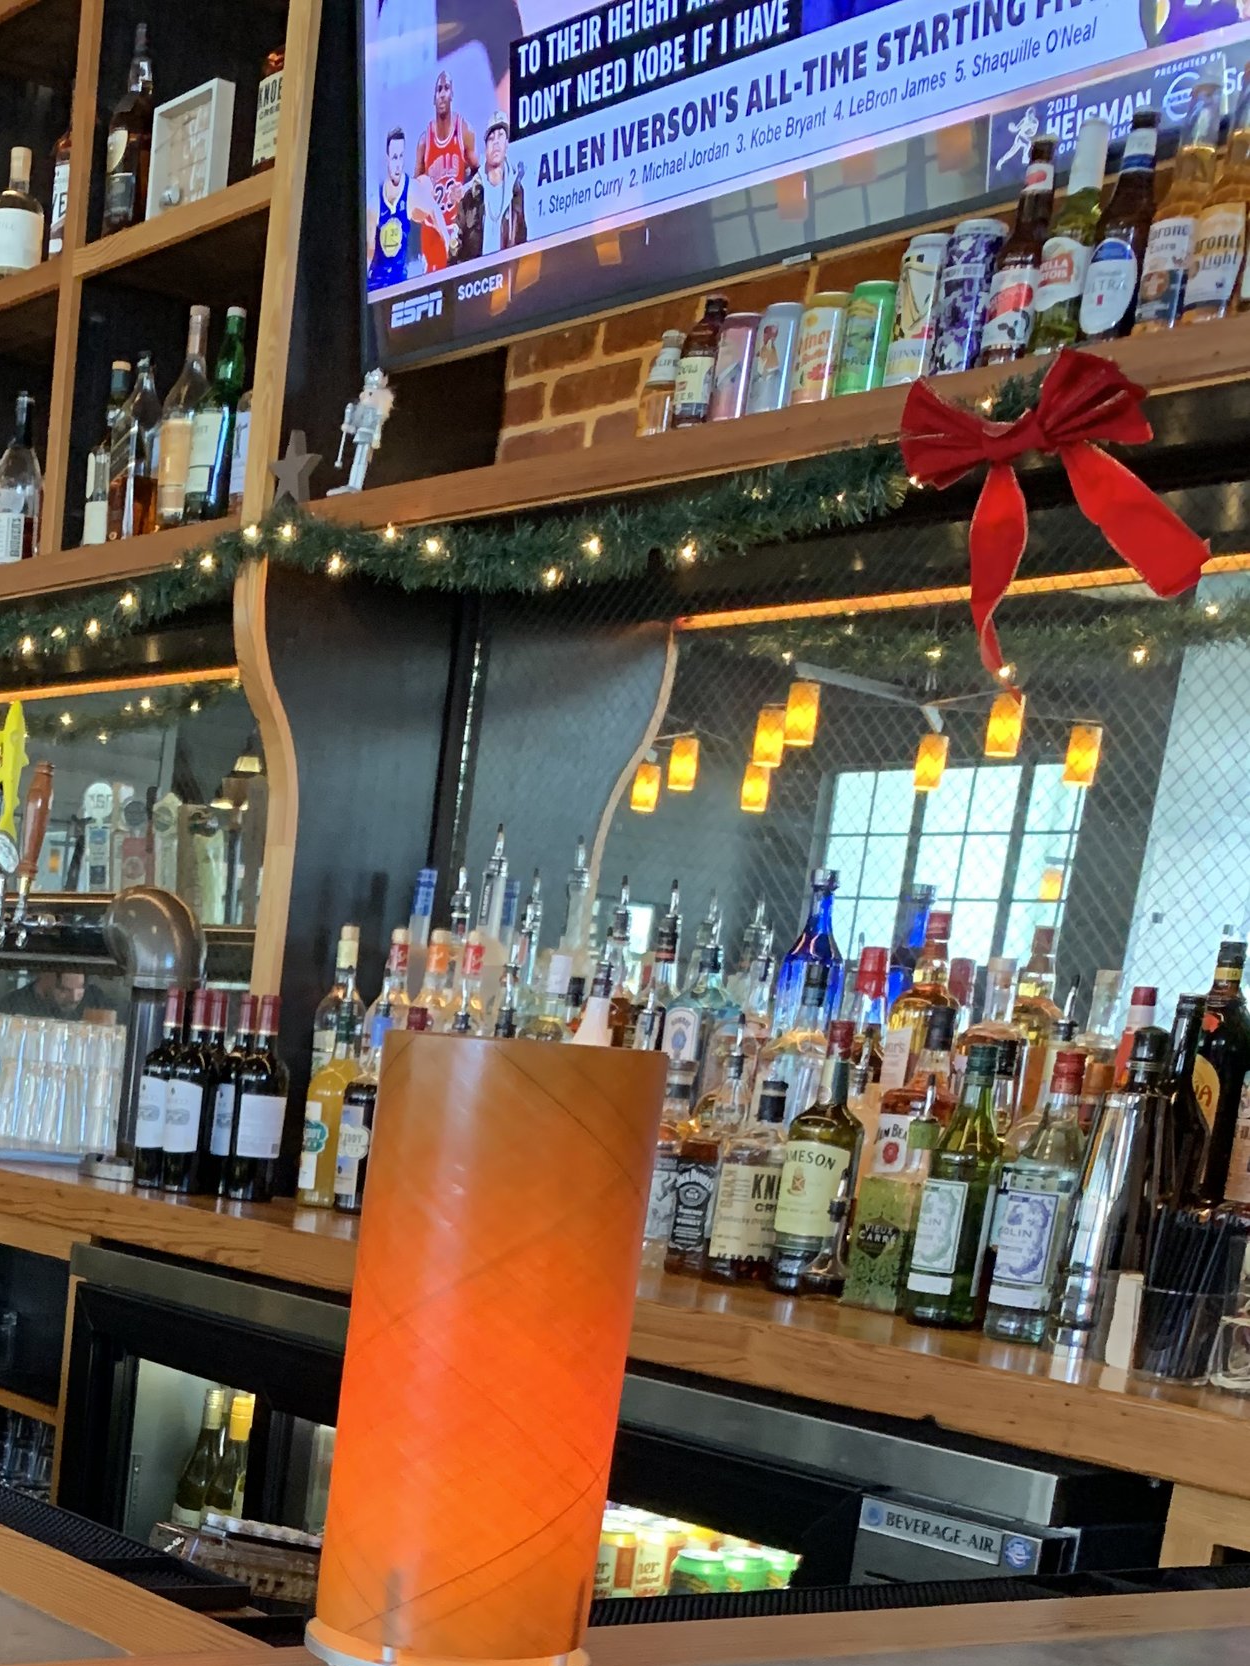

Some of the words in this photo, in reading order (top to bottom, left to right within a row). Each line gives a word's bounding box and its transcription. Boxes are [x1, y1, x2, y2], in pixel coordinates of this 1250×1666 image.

[518, 40, 541, 78] TO
[547, 15, 601, 67] THEIR
[518, 78, 572, 130] DON'T
[577, 58, 627, 107] NEED
[633, 34, 686, 87] KOBE
[693, 23, 714, 65] IF
[720, 17, 729, 55] I
[735, 0, 790, 49] HAVE
[537, 132, 605, 187] ALLEN
[612, 86, 738, 162] IVERSON'S
[746, 40, 868, 117] ALL-TIME
[876, 0, 1026, 72] STARTING
[538, 200, 546, 217] 1.
[548, 186, 591, 215] Stephen
[594, 174, 623, 197] Curry
[629, 168, 640, 189] 2.
[642, 150, 687, 183] Michael
[688, 141, 730, 169] Jordan
[735, 133, 747, 154] 3.
[750, 124, 782, 149] Kobe
[785, 109, 827, 140] Bryant
[833, 103, 845, 120] 4.
[849, 87, 898, 118] LeBron
[900, 70, 947, 100] James
[955, 59, 967, 83] 5.
[971, 37, 1041, 78] Shaquille
[1046, 16, 1097, 53] O'Neal
[391, 290, 443, 328] ESPN
[457, 274, 504, 301] SOCCER
[863, 1222, 895, 1236] VIEUX
[884, 1510, 996, 1554] BEVERAGE-AIR
